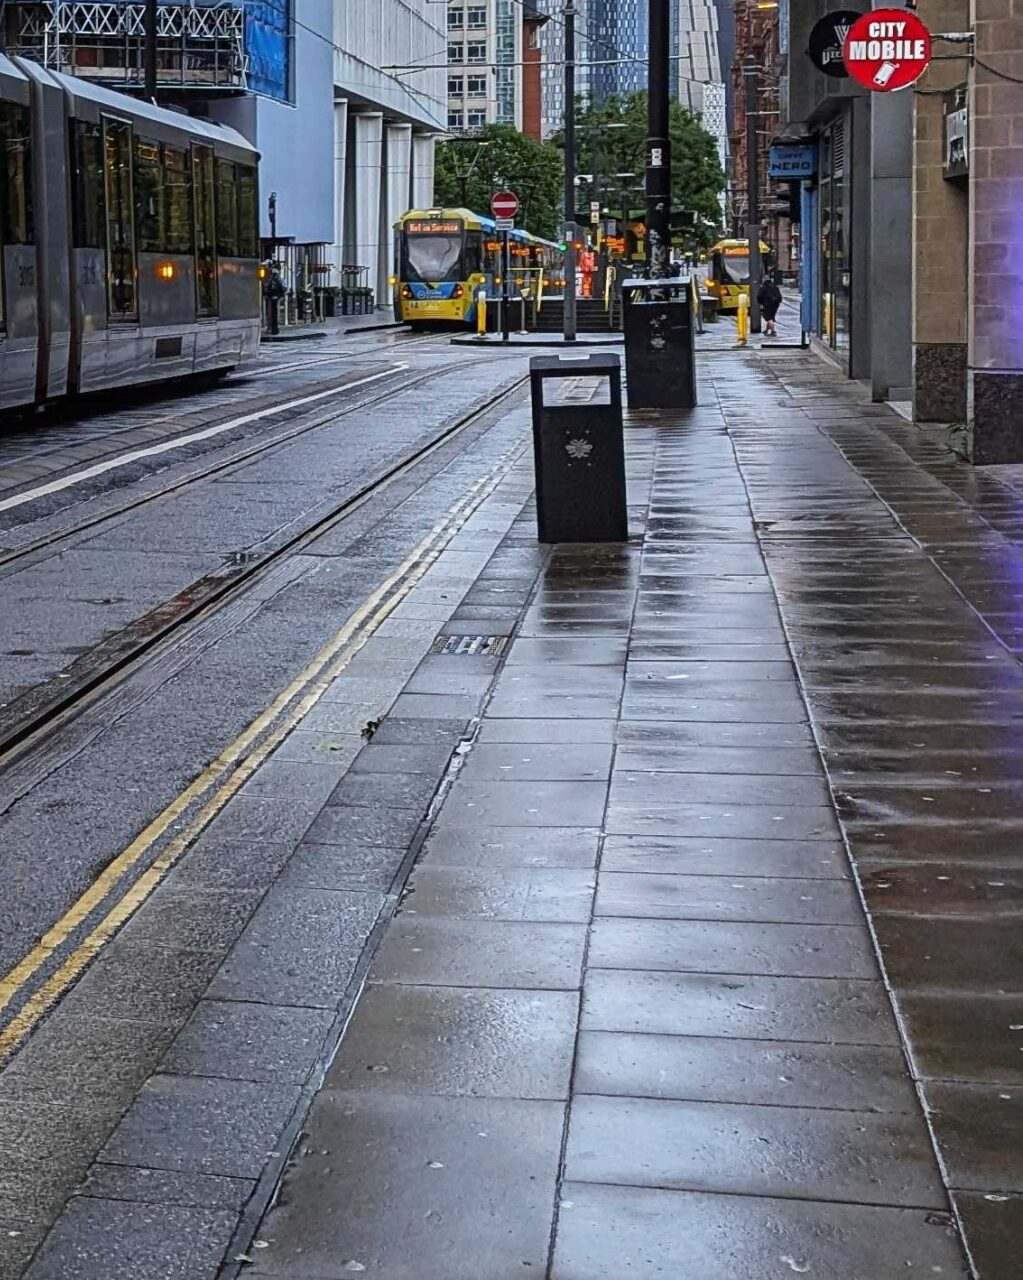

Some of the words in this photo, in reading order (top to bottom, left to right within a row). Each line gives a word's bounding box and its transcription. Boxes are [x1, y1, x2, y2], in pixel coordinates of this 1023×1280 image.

[869, 21, 906, 38] CITY
[849, 39, 925, 60] MOBILE
[772, 161, 811, 171] NERO
